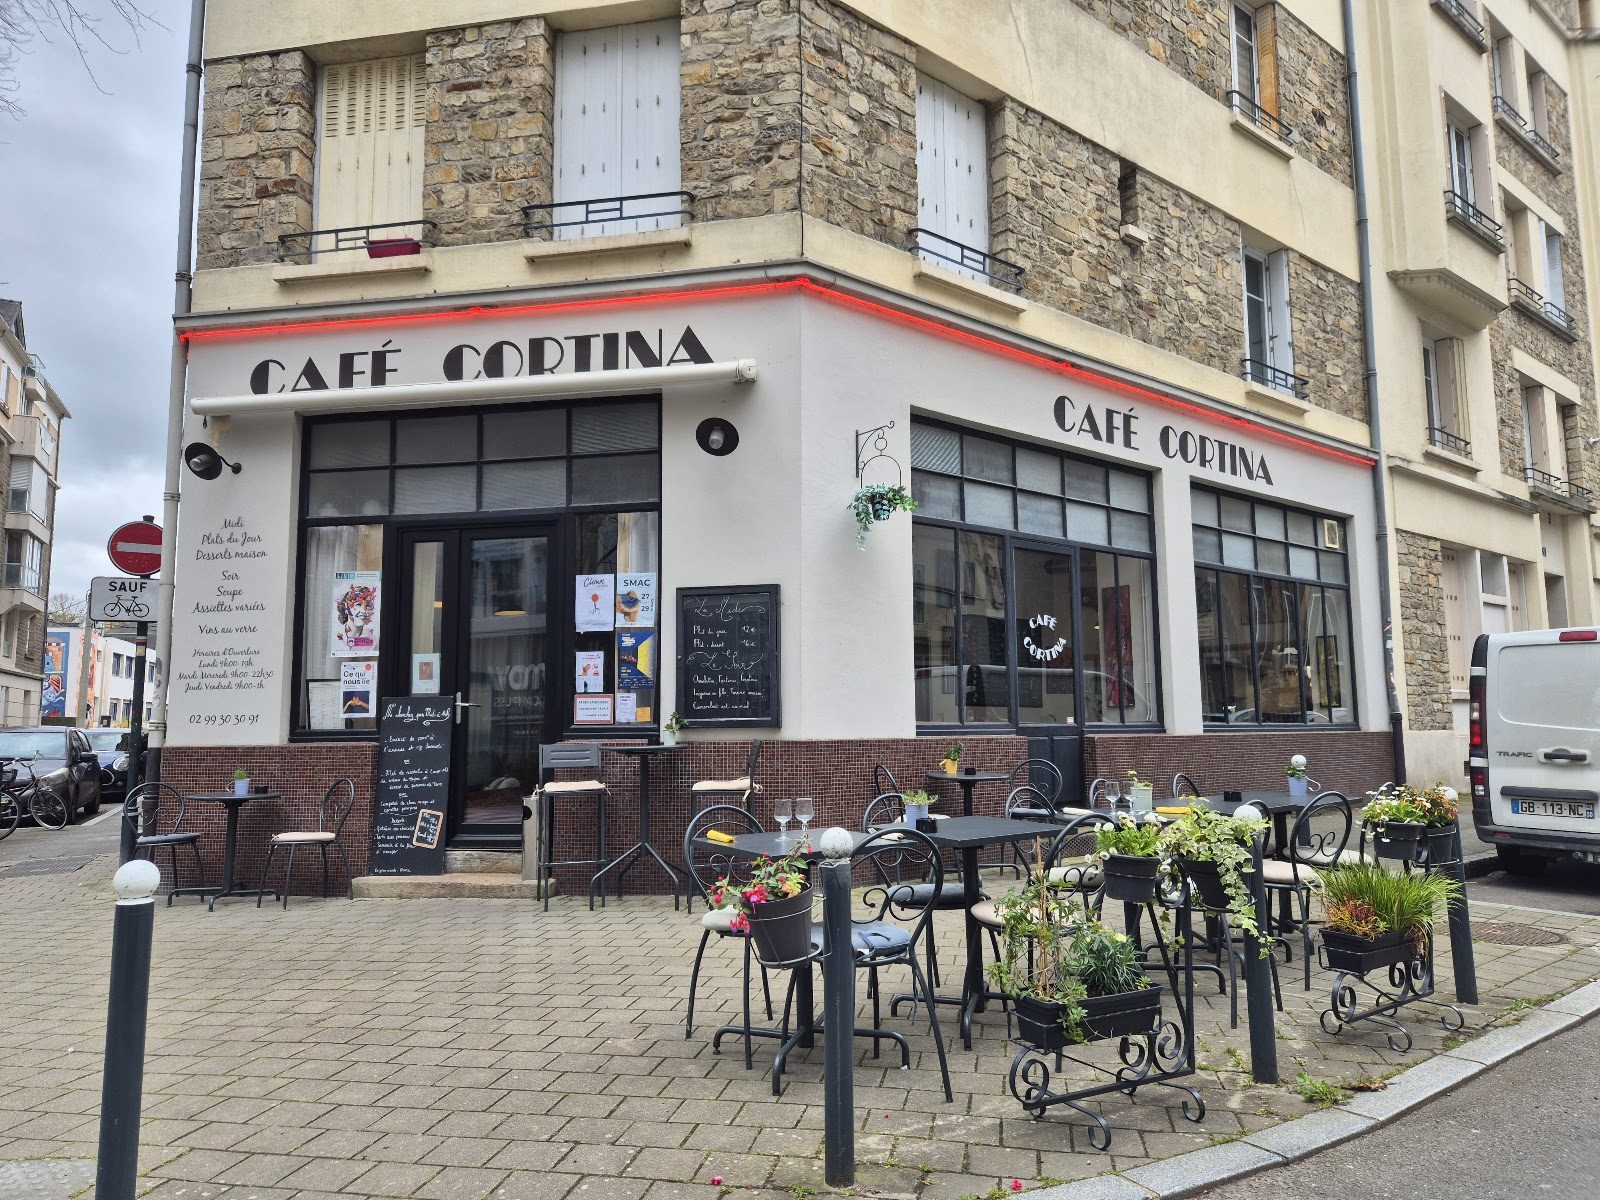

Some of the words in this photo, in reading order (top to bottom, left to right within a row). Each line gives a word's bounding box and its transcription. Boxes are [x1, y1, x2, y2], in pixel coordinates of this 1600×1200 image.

[250, 339, 402, 395] CAFÉ
[443, 324, 714, 382] CORTINA
[1053, 395, 1140, 451] CAFÉ
[1159, 425, 1274, 486] CORTINA
[221, 517, 245, 530] Midi
[201, 534, 224, 545] Plats
[226, 533, 240, 544] du
[240, 532, 262, 546] Jour
[196, 548, 232, 560] Desserts
[234, 550, 268, 559] maison
[221, 570, 240, 580] Soir
[108, 581, 148, 592] SAUF
[624, 579, 650, 587] SMAC
[216, 586, 243, 602] Soupe
[192, 601, 233, 614] Assiettes
[235, 601, 265, 611] variées
[198, 624, 219, 634] Vins
[235, 625, 258, 633] verre
[192, 648, 220, 657] Horaires
[222, 648, 260, 656] d'Ouverture
[1023, 636, 1067, 662] CORTINA
[198, 659, 218, 668] Lundi
[177, 672, 199, 680] Mardi
[200, 671, 229, 680] Mercredi
[185, 683, 204, 693] Jeudi
[205, 682, 234, 691] Vendredi
[190, 714, 202, 724] 02
[204, 714, 216, 726] 99
[218, 714, 232, 726] 30
[233, 714, 246, 726] 30
[249, 714, 259, 725] 91
